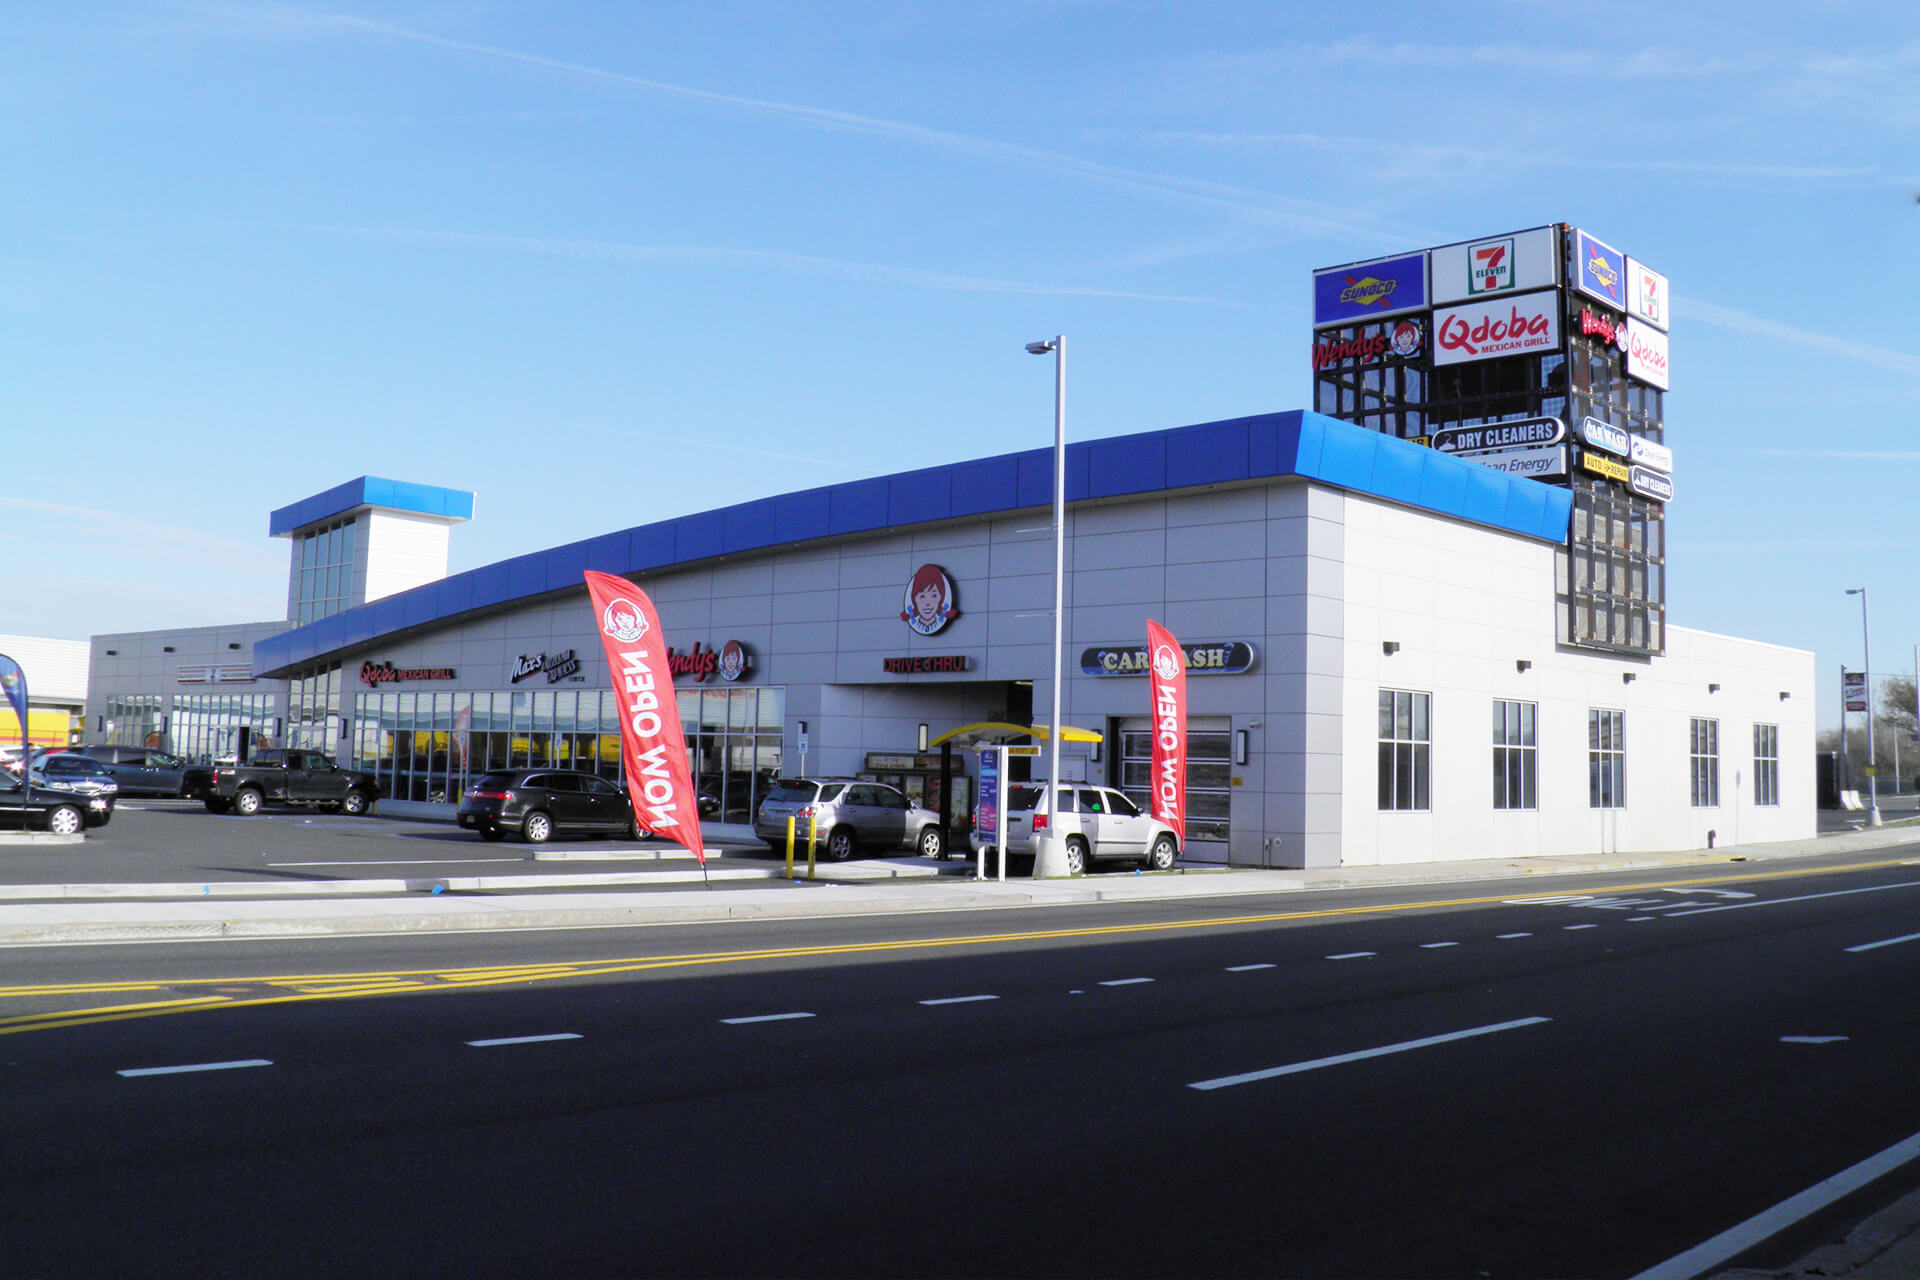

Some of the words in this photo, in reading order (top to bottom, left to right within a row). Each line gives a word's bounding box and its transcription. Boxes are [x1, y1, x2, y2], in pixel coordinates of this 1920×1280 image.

[1476, 245, 1505, 289] 7
[1342, 280, 1395, 301] SUNOCO
[1644, 275, 1656, 316] 7
[1439, 305, 1549, 355] Qdoba
[1312, 328, 1385, 371] Wendy's
[1481, 340, 1522, 354] MEXICAN
[1524, 336, 1550, 348] GRILL
[1457, 431, 1482, 449] DRY
[1485, 422, 1553, 446] CLEANERS
[1509, 458, 1554, 473] Energy
[510, 653, 545, 682] Max's
[668, 641, 715, 682] endy's
[1103, 650, 1149, 670] CAR
[360, 661, 396, 688] Qdoba
[398, 669, 429, 681] MEXICAN
[430, 669, 451, 680] GRILL
